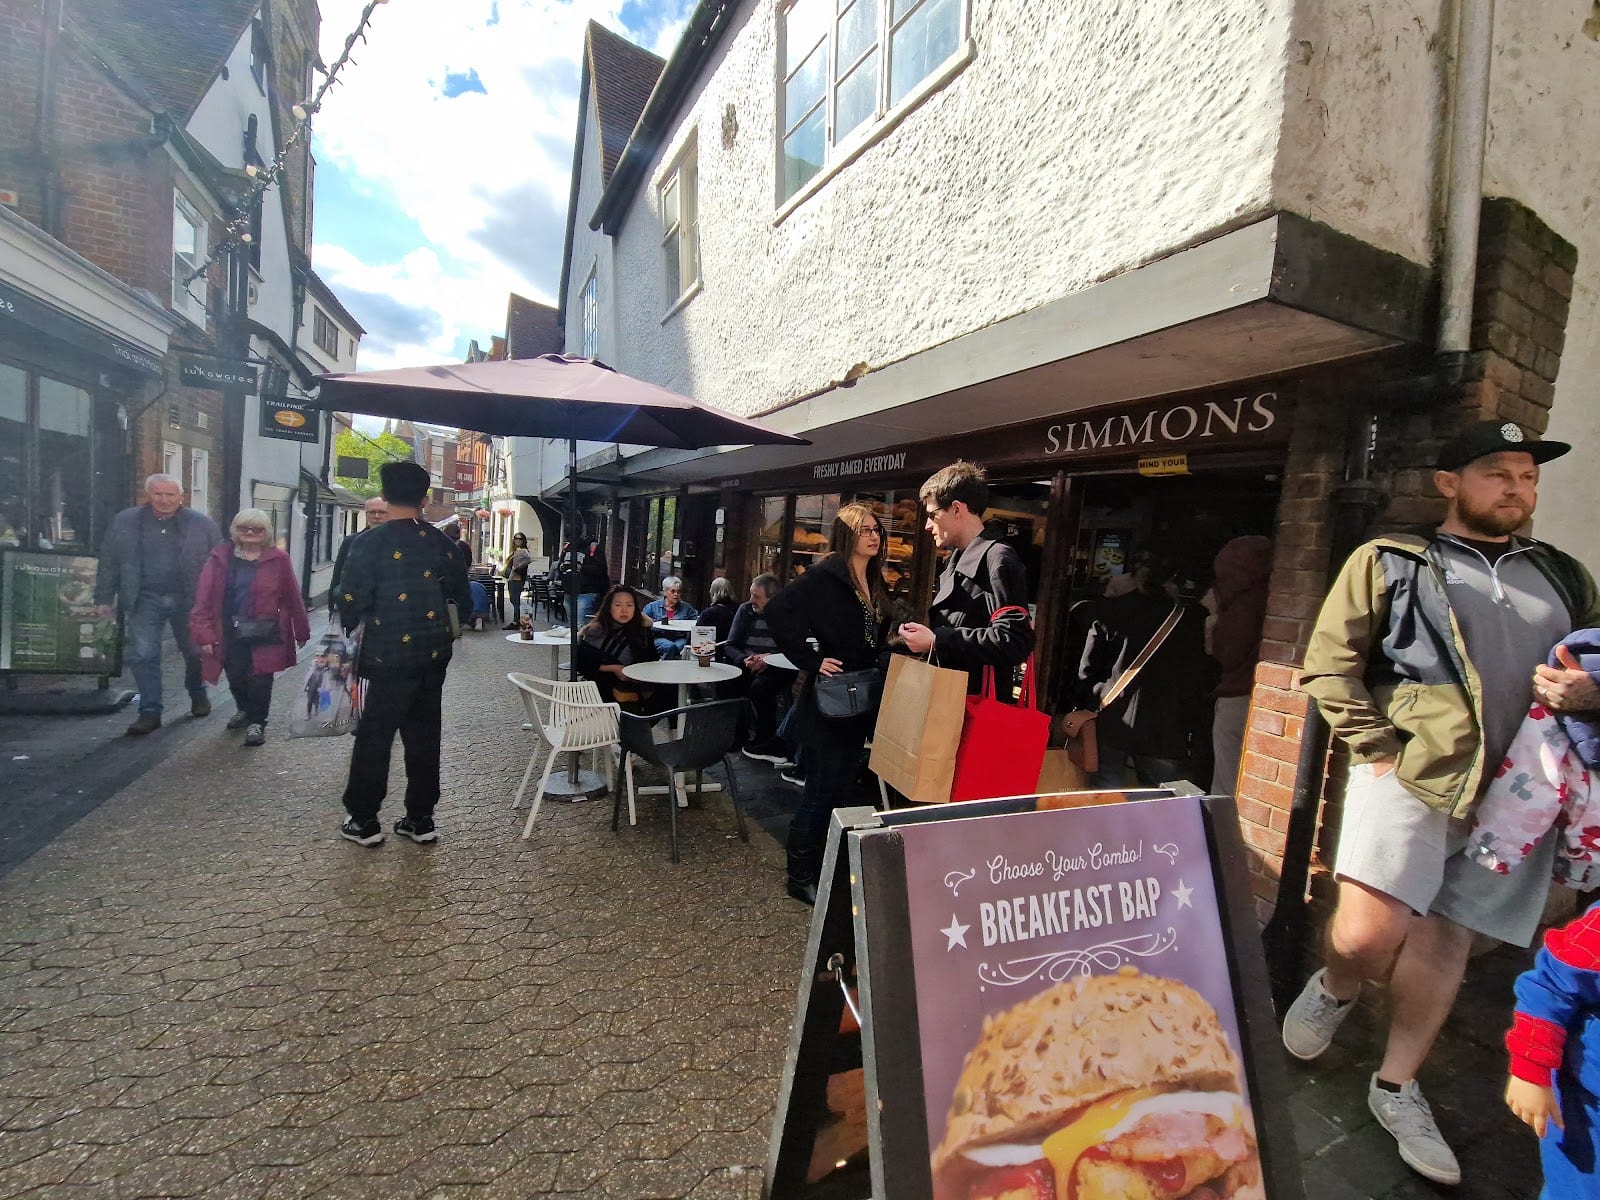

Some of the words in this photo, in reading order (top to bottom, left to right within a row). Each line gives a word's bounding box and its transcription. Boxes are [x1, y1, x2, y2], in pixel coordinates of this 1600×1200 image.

[1044, 392, 1278, 454] SIMMONS
[813, 462, 840, 478] FRESHLY
[840, 459, 863, 476] BAKED
[863, 452, 907, 473] EVERYDAY
[1139, 460, 1160, 469] MIND
[1162, 458, 1185, 468] YOUR
[986, 855, 1045, 885] Choose
[1045, 850, 1088, 882] Your
[1087, 840, 1143, 870] Combo!
[979, 883, 1114, 947] BREAKFAST
[1118, 877, 1161, 922] BAP
